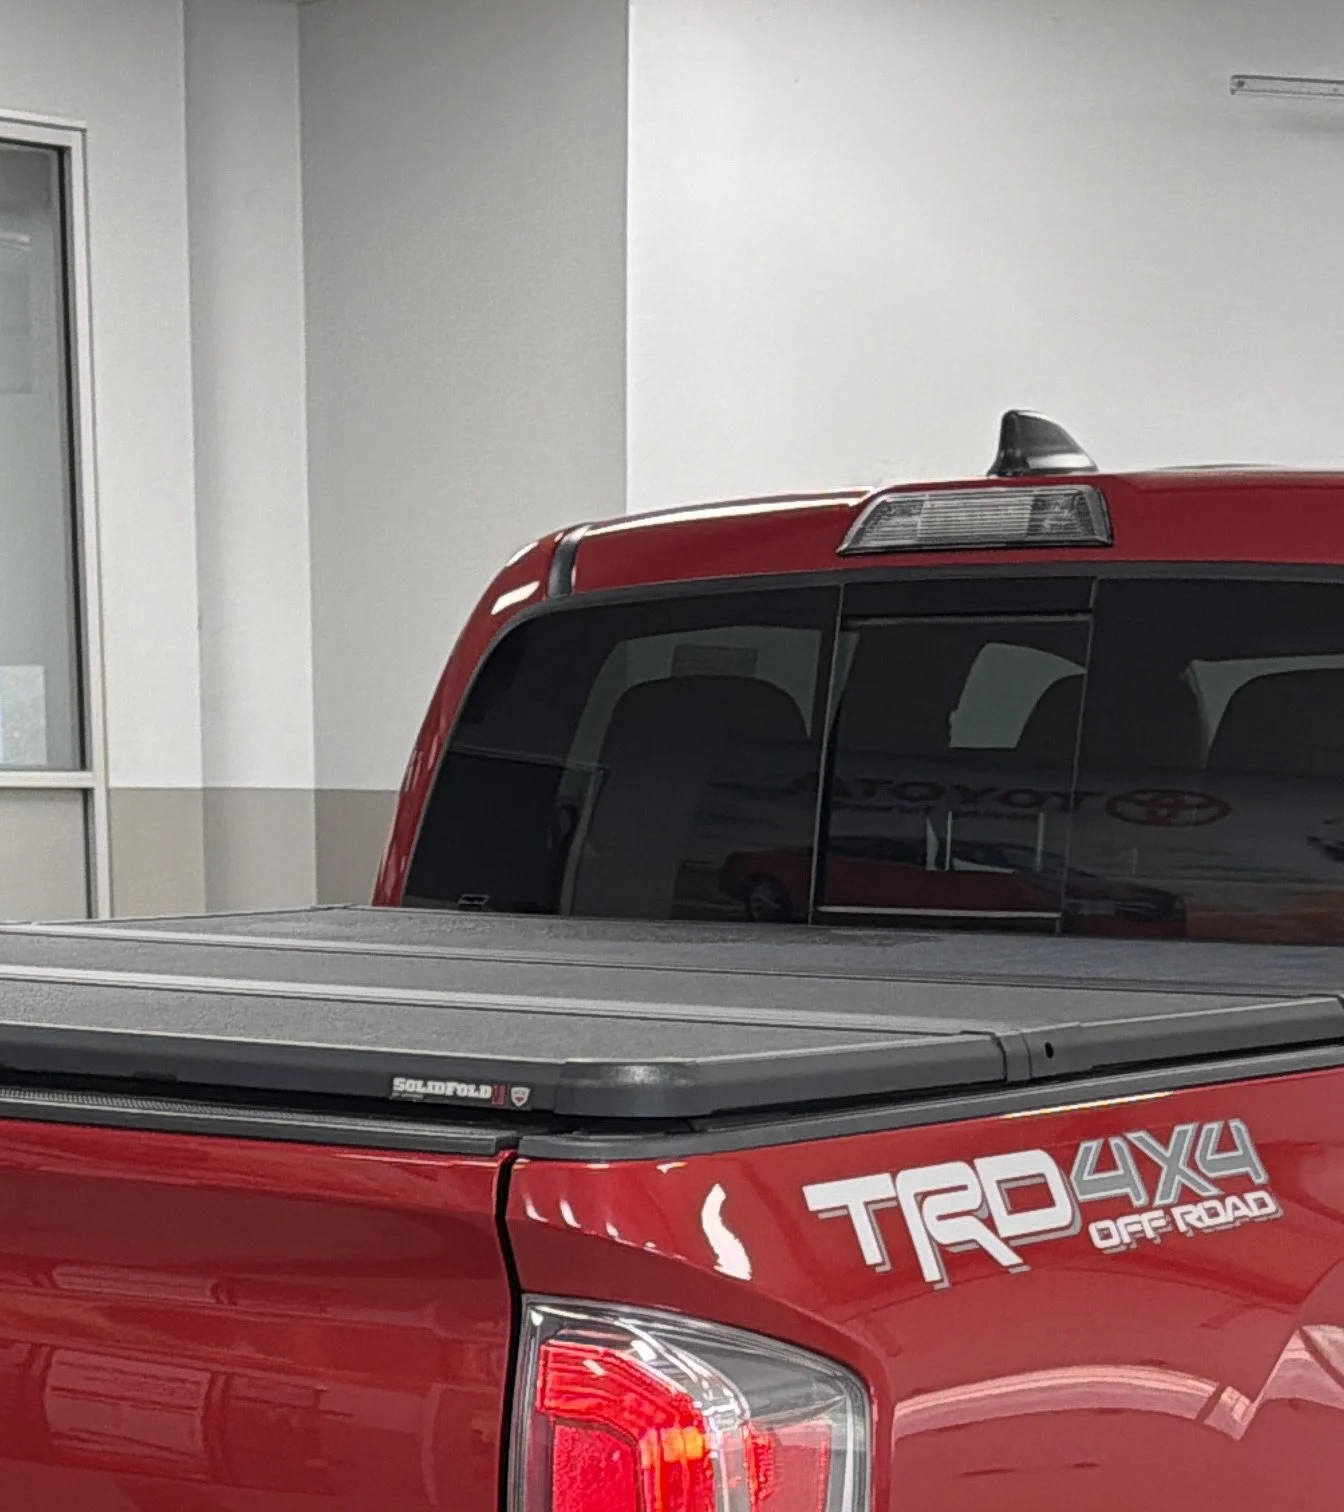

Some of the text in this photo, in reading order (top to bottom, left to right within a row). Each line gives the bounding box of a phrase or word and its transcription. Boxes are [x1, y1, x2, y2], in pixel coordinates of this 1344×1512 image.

[393, 1077, 492, 1099] SOLIDFOLD
[802, 1148, 1081, 1290] TRD
[1088, 1190, 1283, 1254] OFF ROAD
